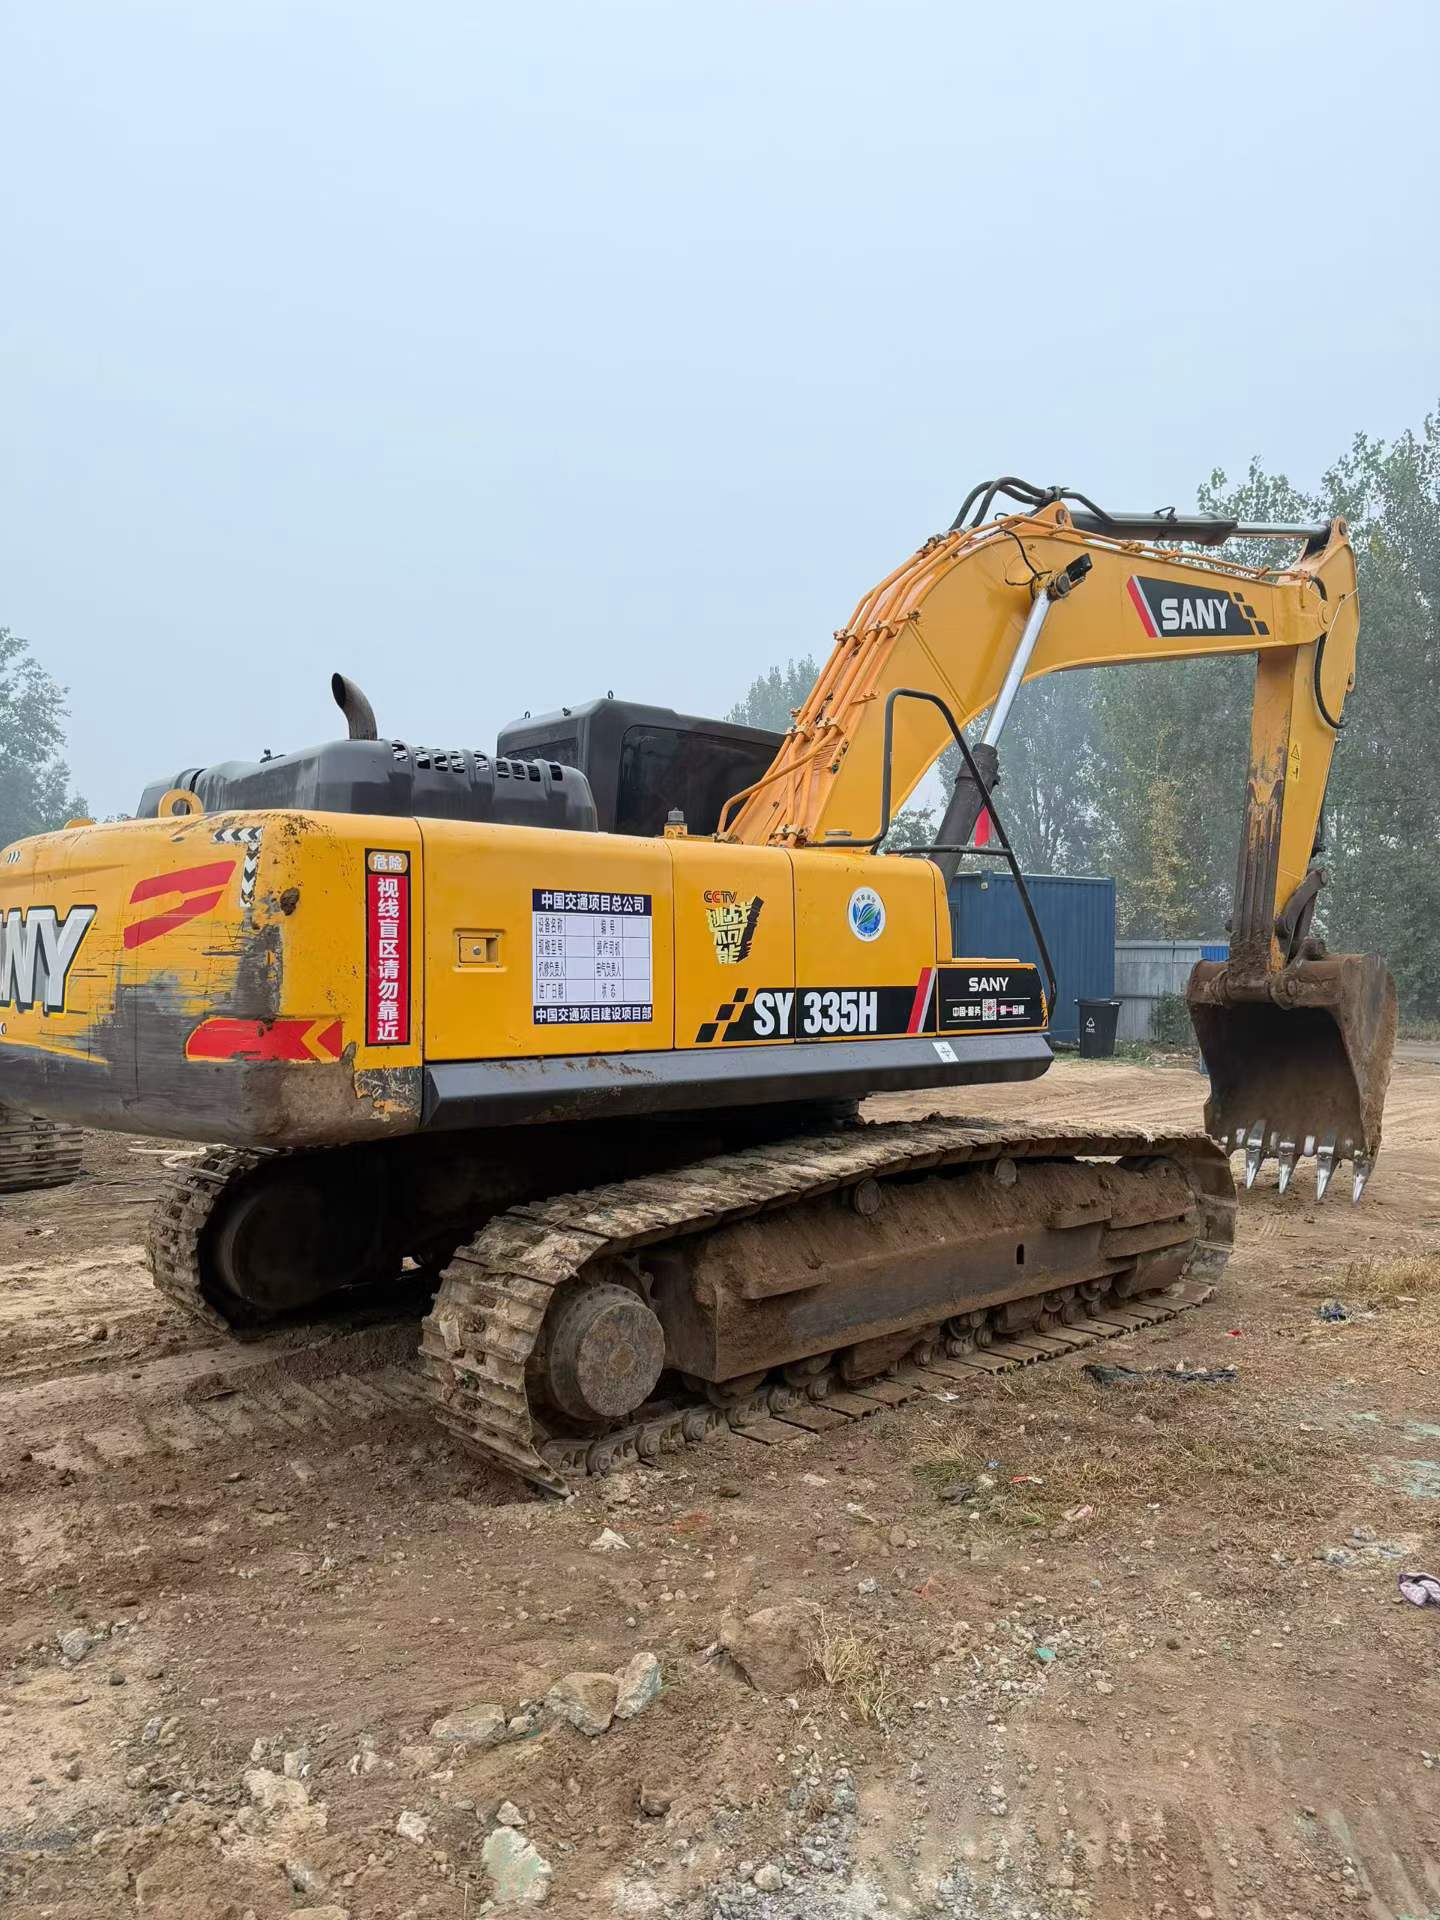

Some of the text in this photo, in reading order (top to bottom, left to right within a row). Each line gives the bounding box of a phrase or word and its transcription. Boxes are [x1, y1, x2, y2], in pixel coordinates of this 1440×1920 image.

[1161, 598, 1229, 630] SANY
[374, 855, 403, 871] 危险
[541, 892, 645, 913] 中国交通项目总公司
[704, 890, 737, 904] CCTV
[539, 917, 563, 935] 设备名称
[0, 905, 97, 1014] NY
[377, 877, 400, 1041] 视线盲区请勿靠近
[969, 977, 1009, 992] SANY
[535, 1006, 651, 1023] 中国交通项目建设项目部
[754, 991, 878, 1036] SY 335H
